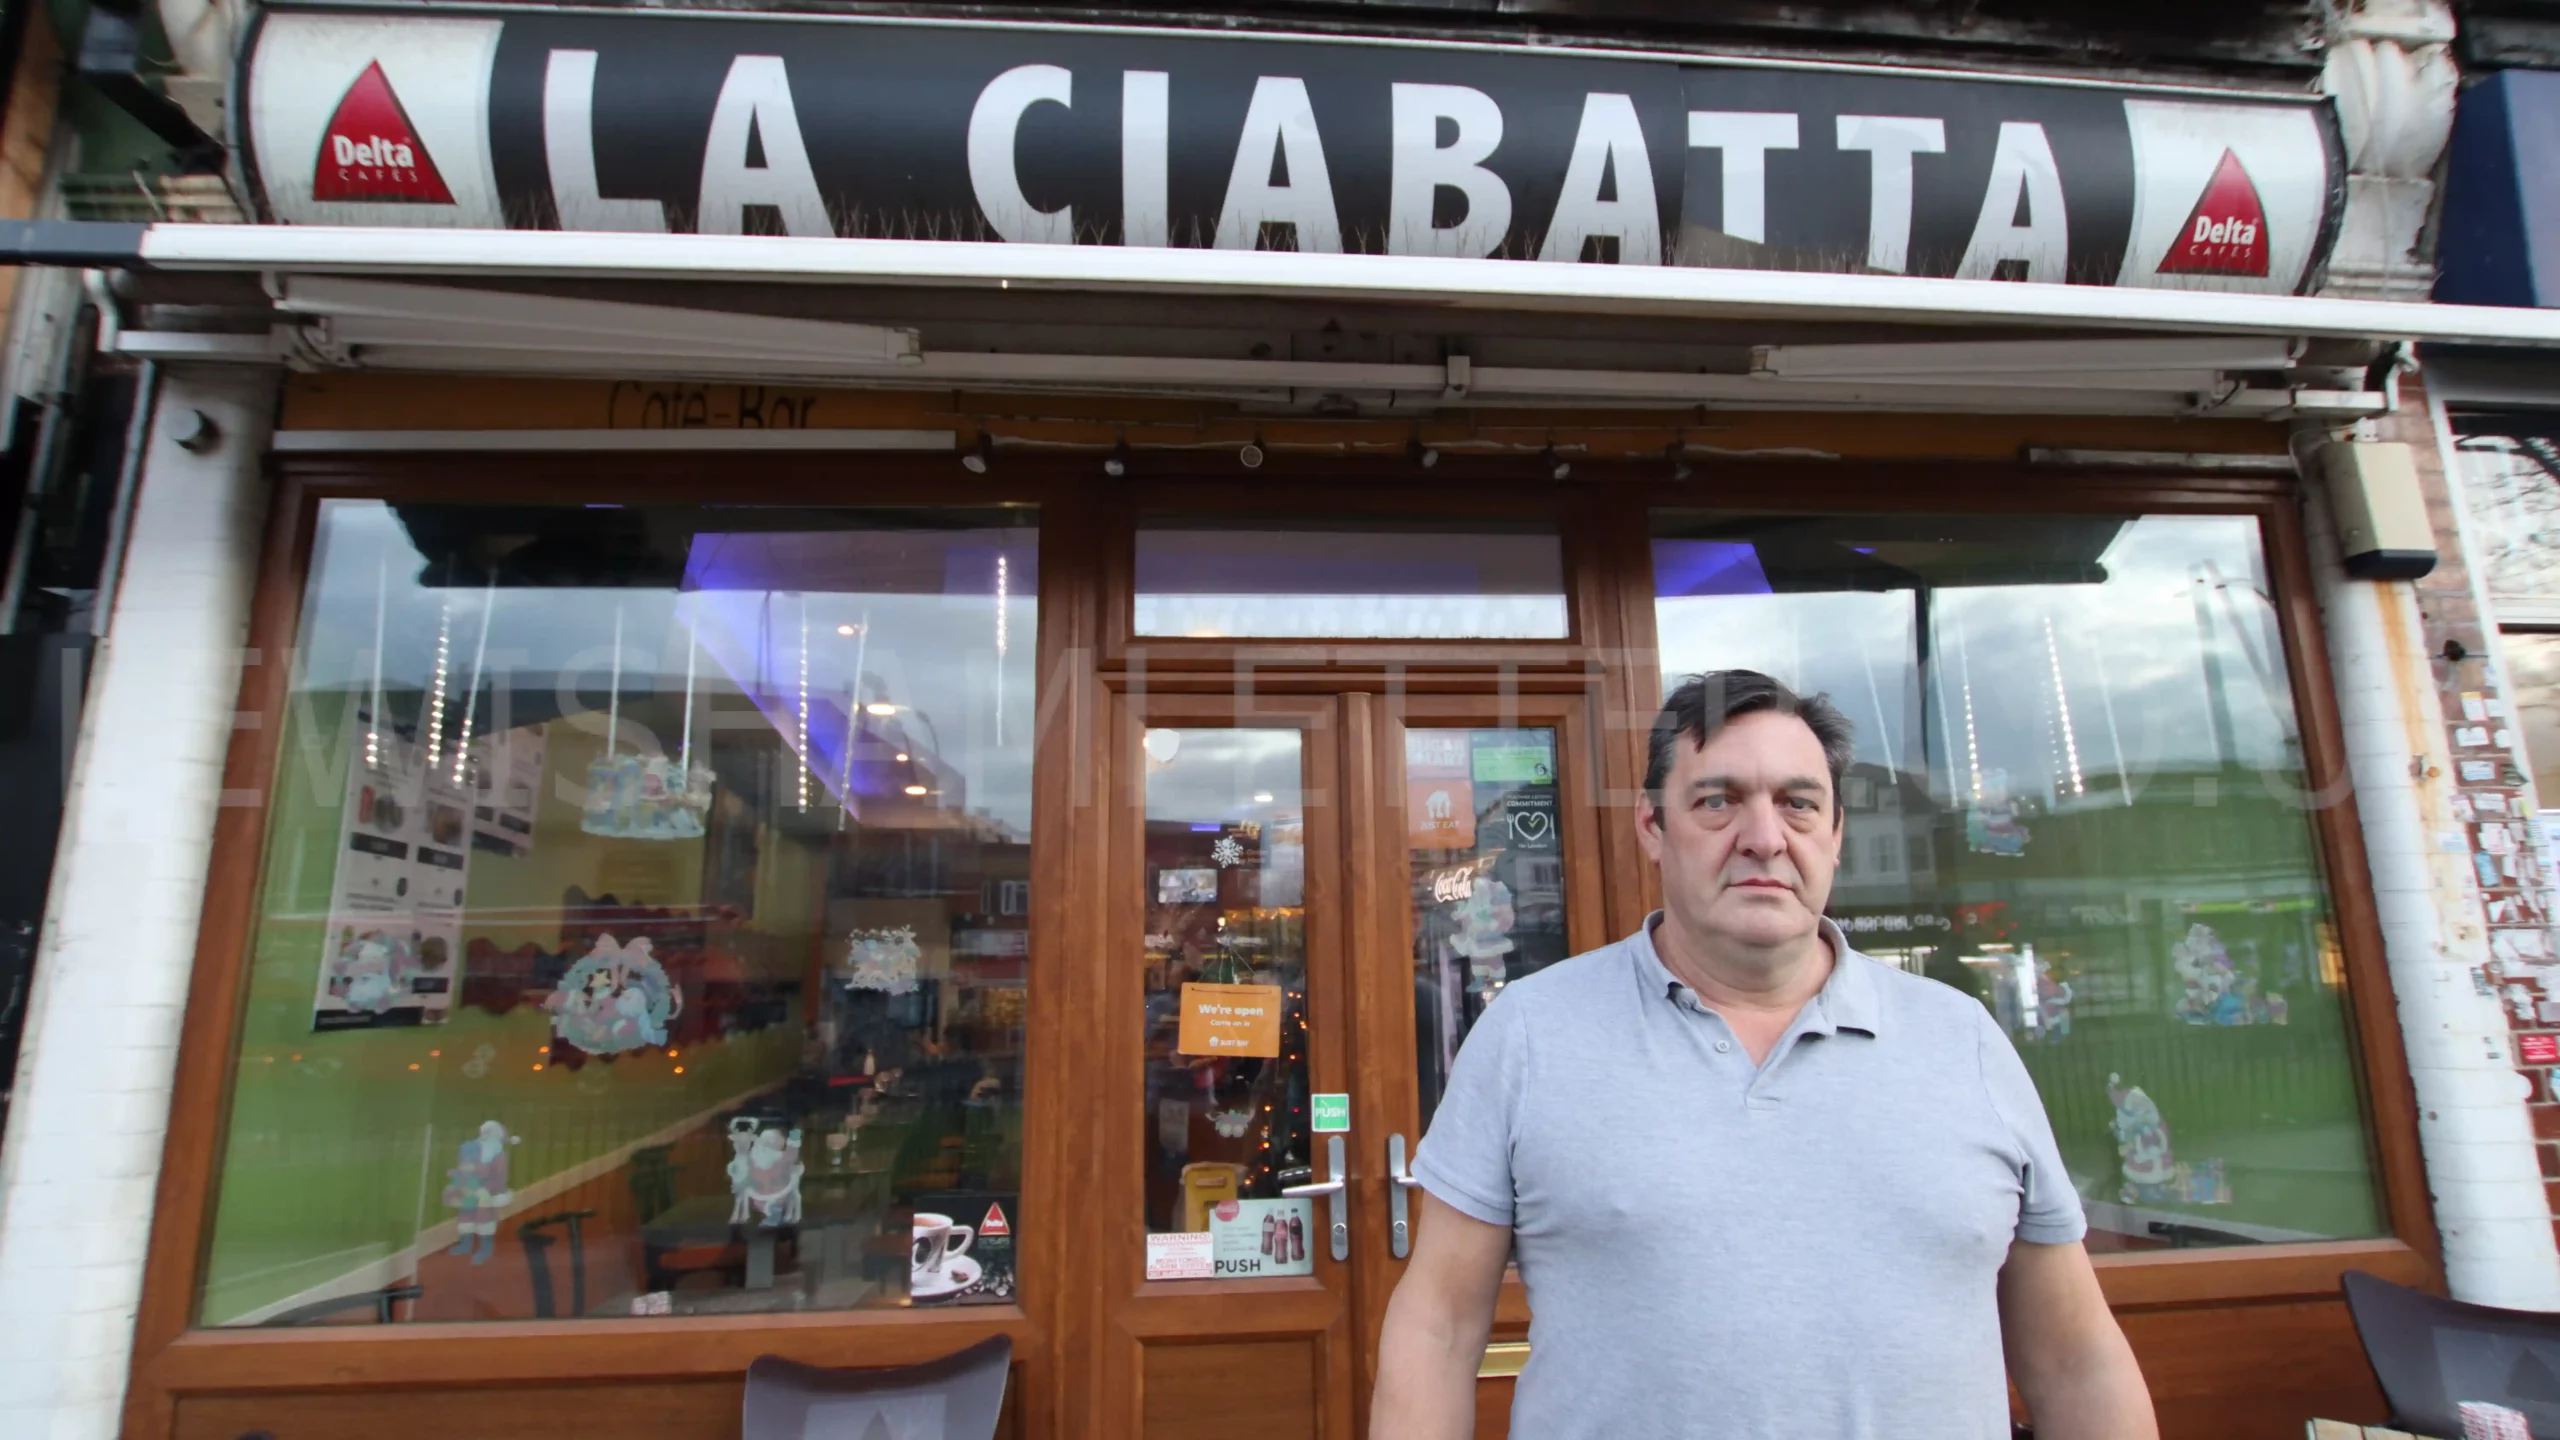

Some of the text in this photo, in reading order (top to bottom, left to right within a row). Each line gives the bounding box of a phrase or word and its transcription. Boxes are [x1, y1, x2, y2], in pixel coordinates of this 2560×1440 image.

[332, 134, 415, 168] Delta
[543, 49, 2069, 284] LA CIABATTA
[2193, 215, 2256, 245] Delta
[1234, 1007, 1264, 1018] open
[1315, 1107, 1346, 1118] PUSH
[1214, 1259, 1261, 1274] PUSH
